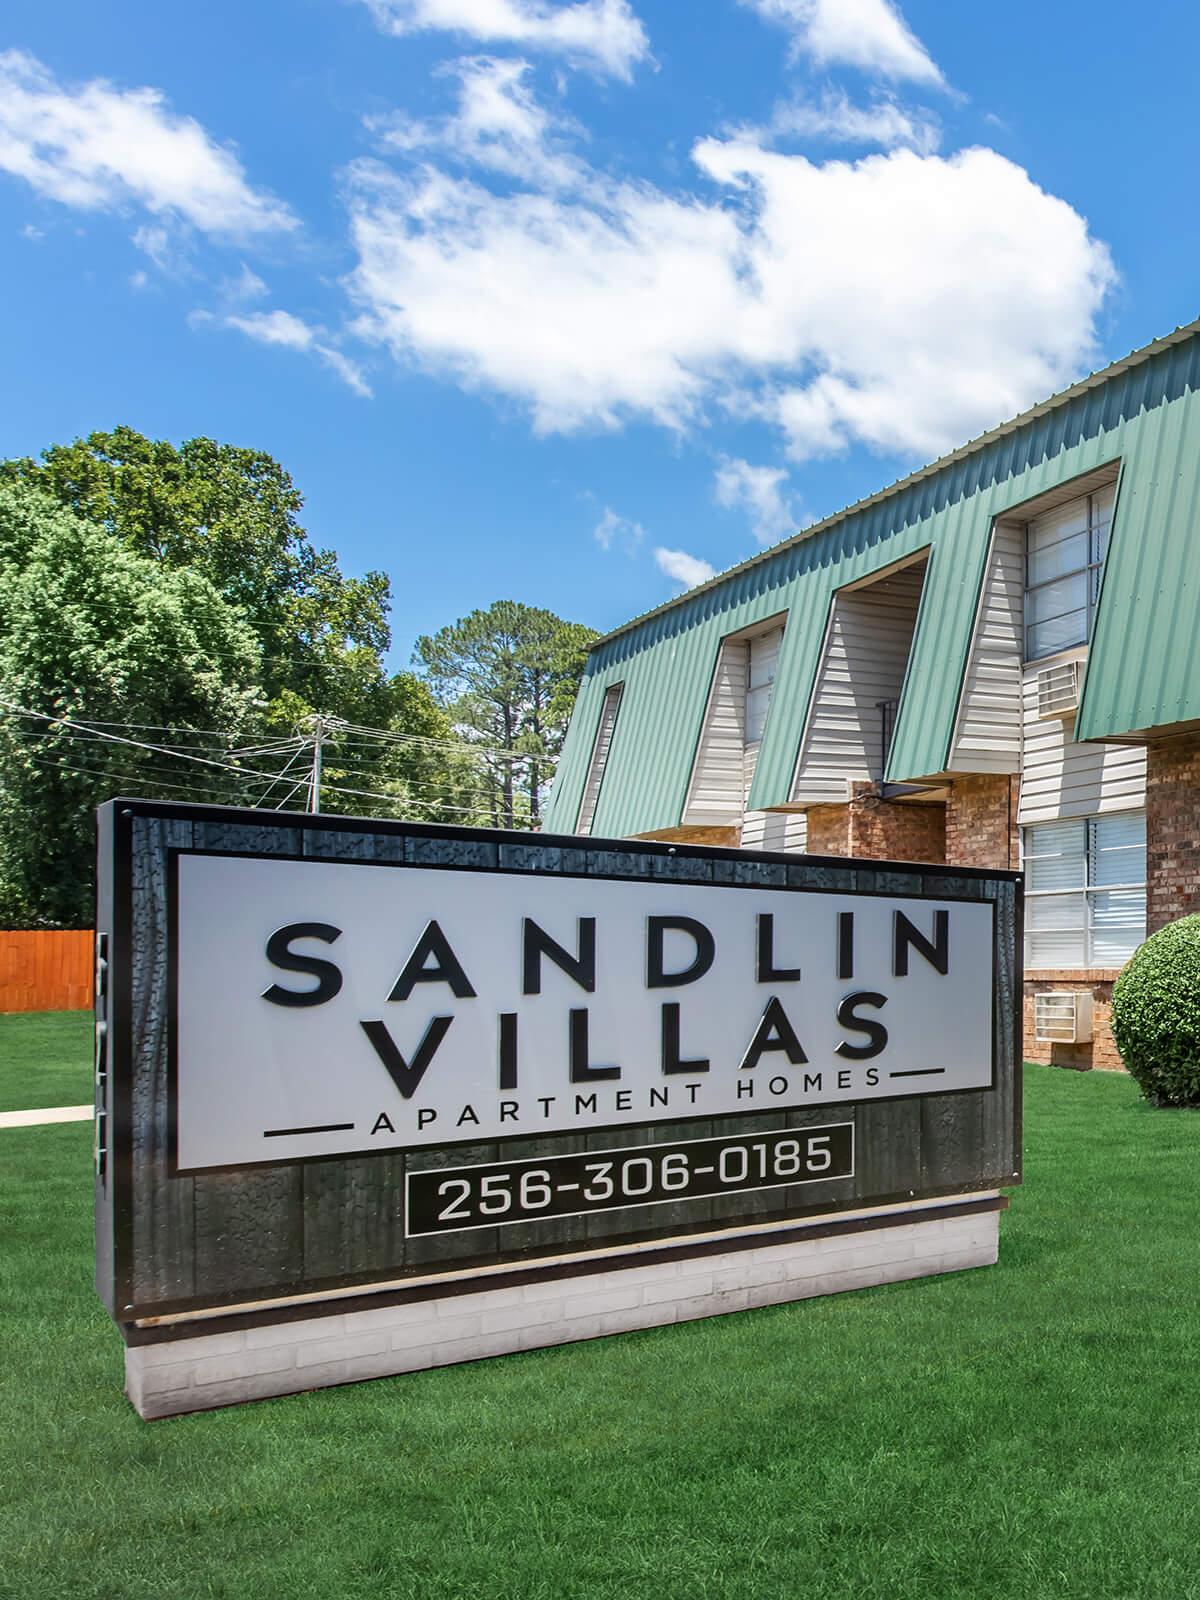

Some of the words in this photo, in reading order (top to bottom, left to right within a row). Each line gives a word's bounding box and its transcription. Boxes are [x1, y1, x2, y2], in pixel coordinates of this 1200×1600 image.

[260, 908, 950, 1008] SANDLIN
[360, 991, 889, 1099] VILLAS
[370, 1082, 704, 1136] APARTMENT
[736, 1066, 883, 1099] HOMES
[436, 1135, 834, 1220] 256-306-0185
